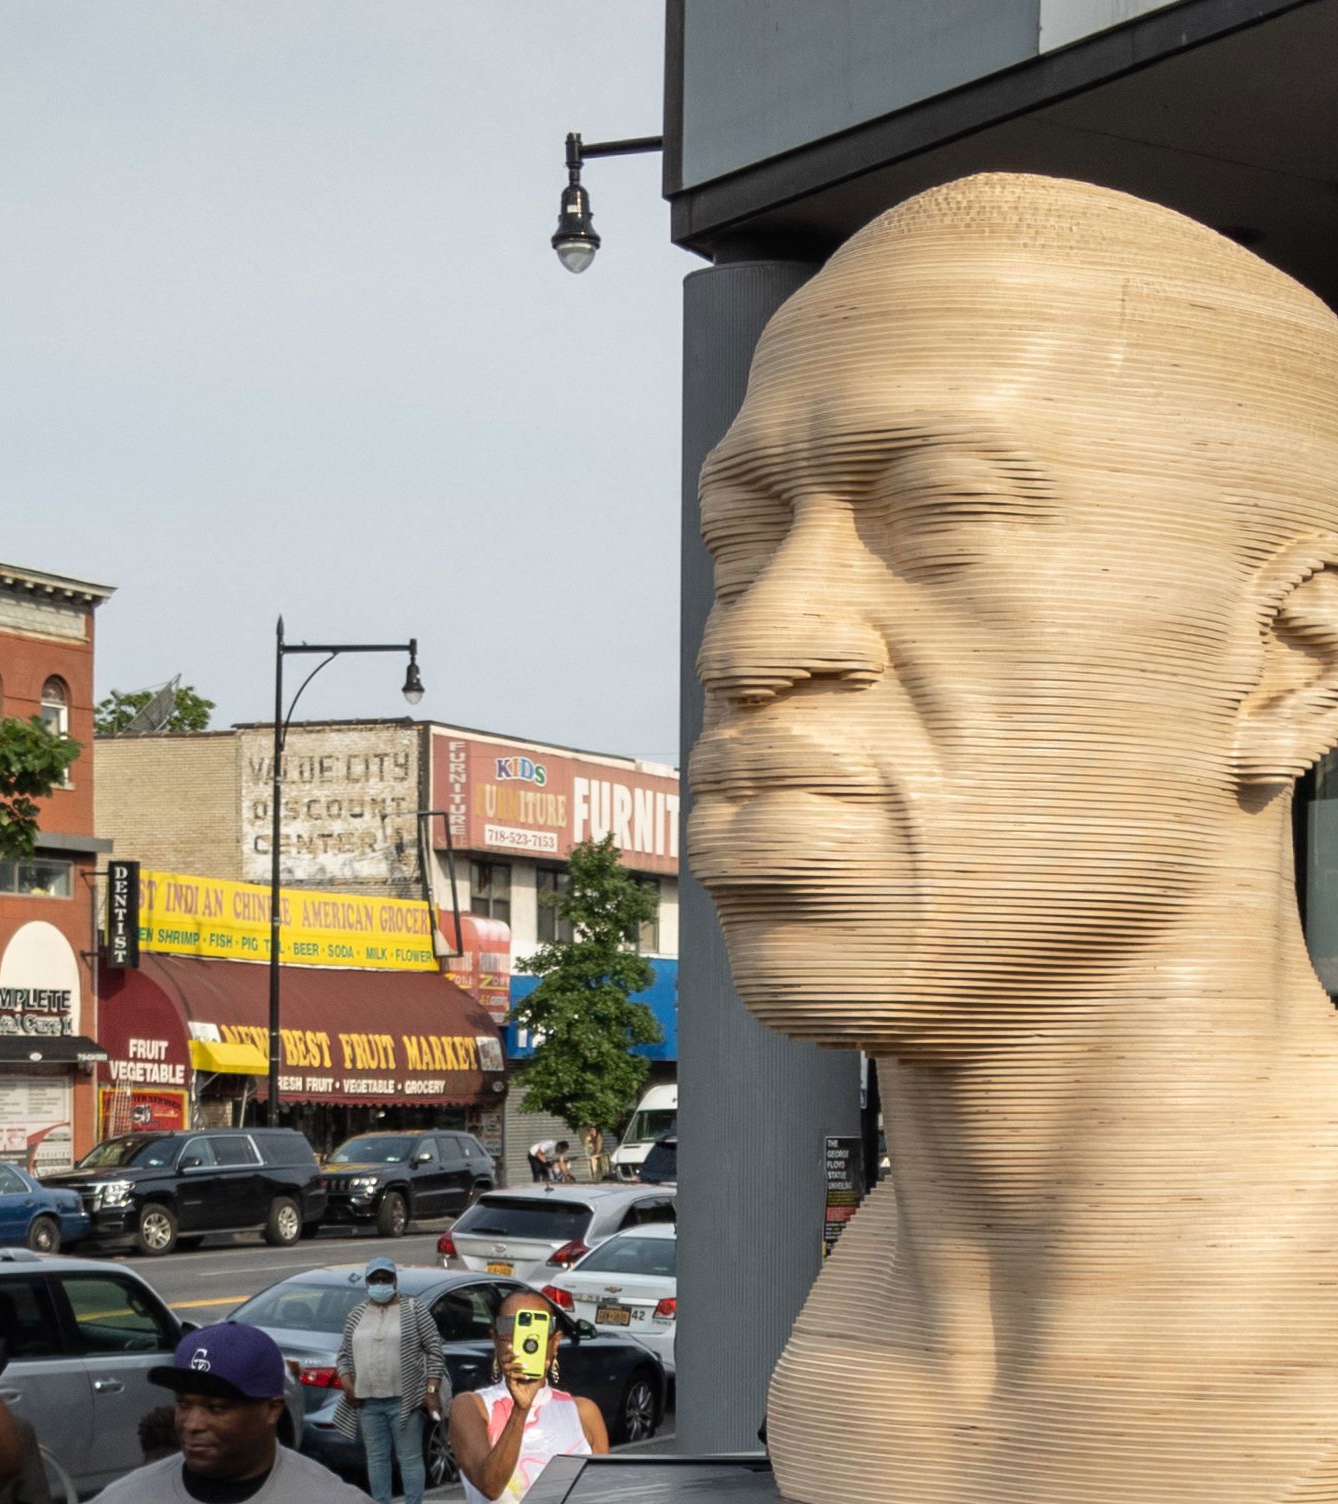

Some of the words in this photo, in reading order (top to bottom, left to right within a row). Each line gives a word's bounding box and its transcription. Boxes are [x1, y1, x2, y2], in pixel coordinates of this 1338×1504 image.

[346, 752, 409, 782] CITY
[495, 756, 547, 787] KIDS
[449, 741, 466, 835] FURNITURE
[253, 797, 406, 820] DSCOUNT
[476, 783, 567, 827] FURNITURE
[487, 828, 555, 849] 718-523-7153
[114, 866, 128, 963] DENTIST
[139, 878, 157, 911] ST
[233, 890, 291, 926] CHINE
[302, 900, 374, 932] AMERICAN
[158, 928, 200, 946] SHRIMP
[211, 932, 233, 949] FISH
[241, 936, 259, 951] PIG
[263, 938, 284, 954] TL
[293, 942, 319, 956] BEER
[328, 944, 354, 959] SODA
[366, 947, 387, 961] MILK
[129, 1038, 169, 1061] FRUIT
[281, 1028, 332, 1068] BEST
[339, 1033, 396, 1070] FRUIT
[403, 1035, 478, 1071] MARKET
[110, 1060, 185, 1085] VEGETABLE
[306, 1077, 333, 1092] FRUIT
[344, 1078, 395, 1094] VEGETABLE
[405, 1079, 445, 1094] GROCERY
[632, 1310, 645, 1320] 42
